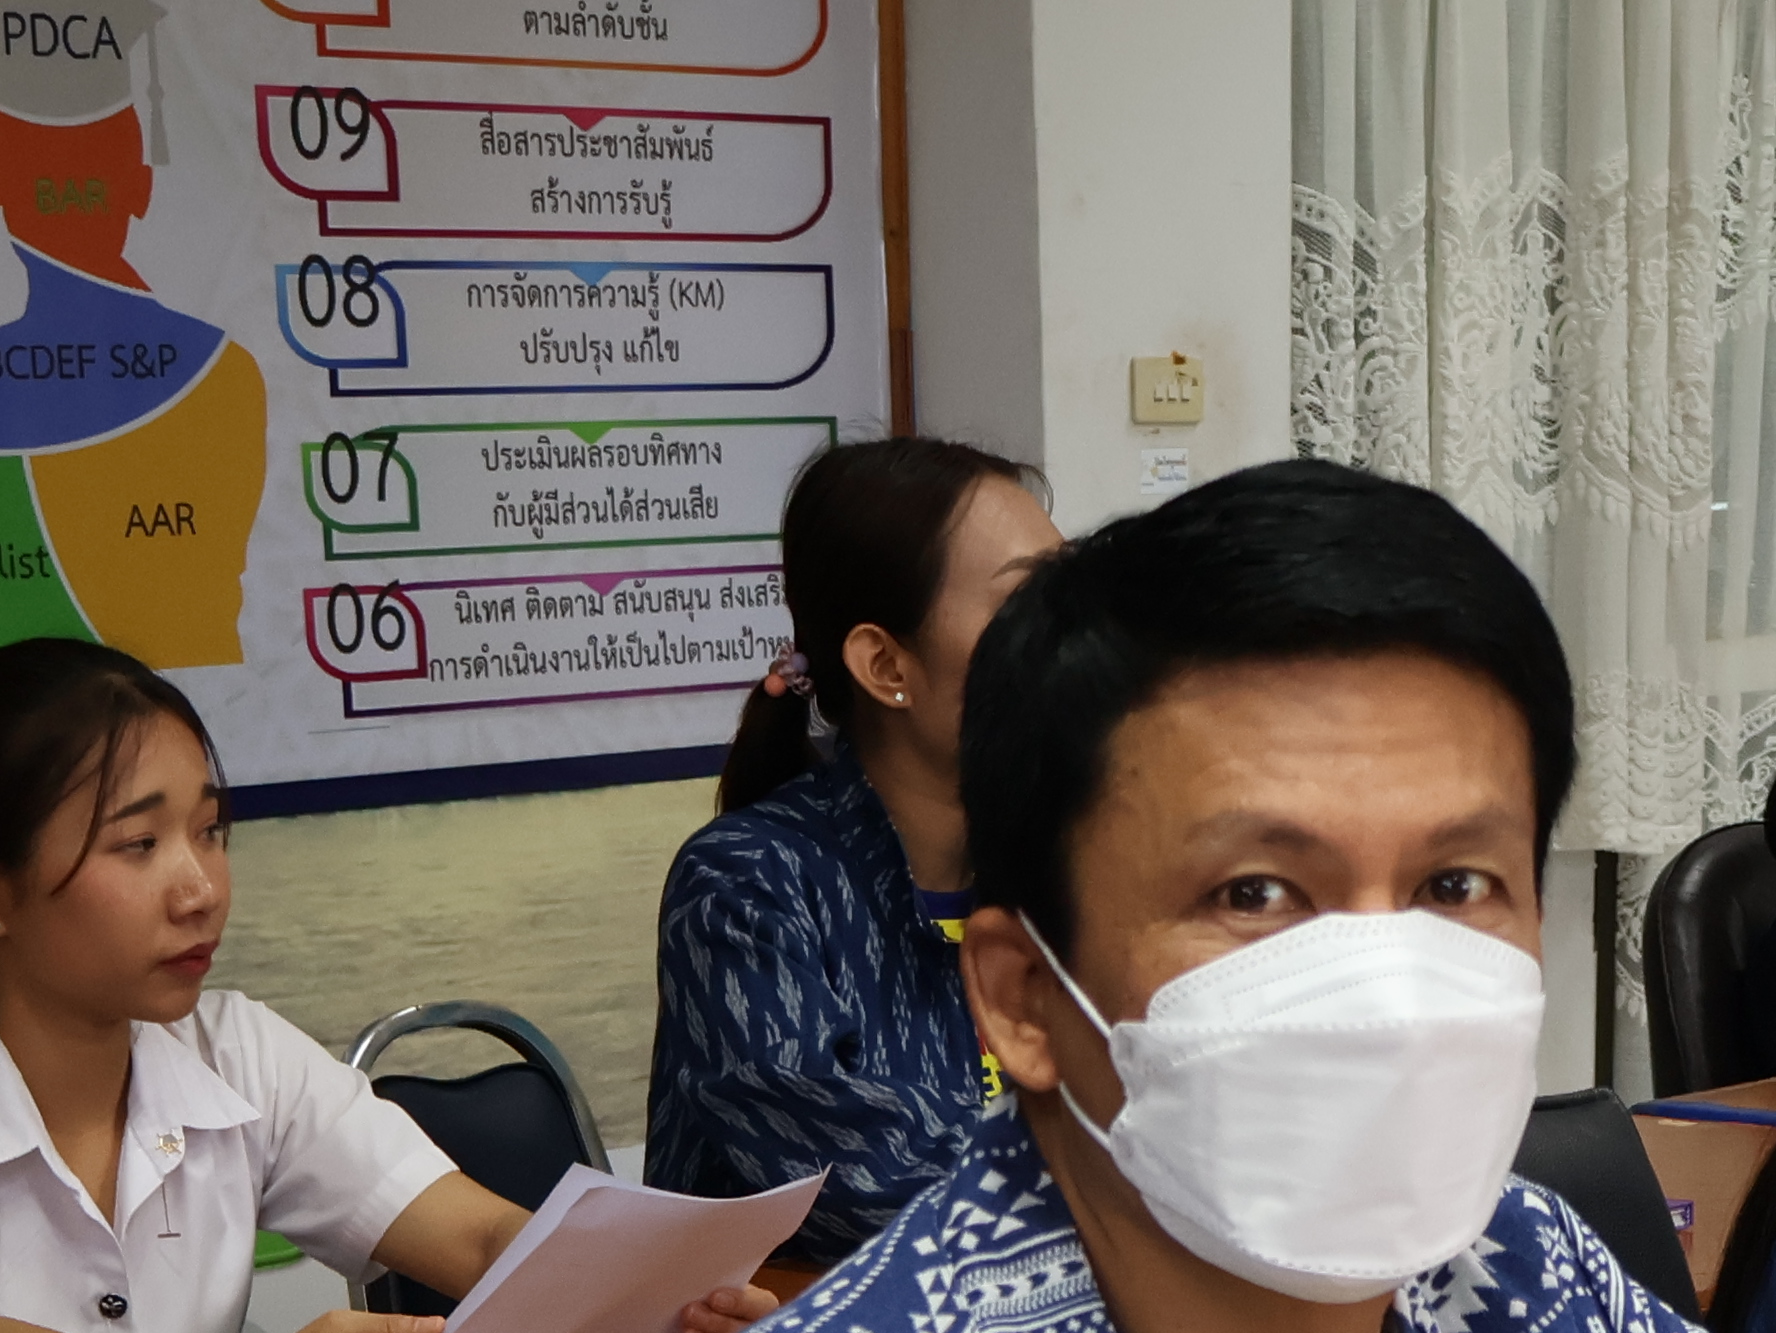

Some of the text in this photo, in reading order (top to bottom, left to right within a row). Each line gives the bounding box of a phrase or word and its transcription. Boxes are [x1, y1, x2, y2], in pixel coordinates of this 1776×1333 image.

[2, 10, 124, 61] PDCA
[290, 85, 371, 161] 09
[480, 111, 715, 162] สื่อสารประชาสัมพันธ์
[34, 177, 110, 216] BAR
[531, 176, 674, 230] สร้างการรับรู้
[297, 253, 380, 328] 08
[467, 271, 726, 322] การจัดการความรู้ (KM)
[110, 342, 178, 380] S&P
[519, 326, 680, 375] ปรับปรุง แก้ไข
[321, 430, 399, 504] 07
[481, 431, 723, 471] ประเมินผลรอบทิศทาง
[124, 502, 197, 538] AAR
[492, 484, 720, 539] กับผู้มีส่วนได้ส่วนเสีย
[326, 579, 406, 655] 06
[454, 574, 786, 626] นิเทศ ติดตาม สนับสนุน ส่งเสริ
